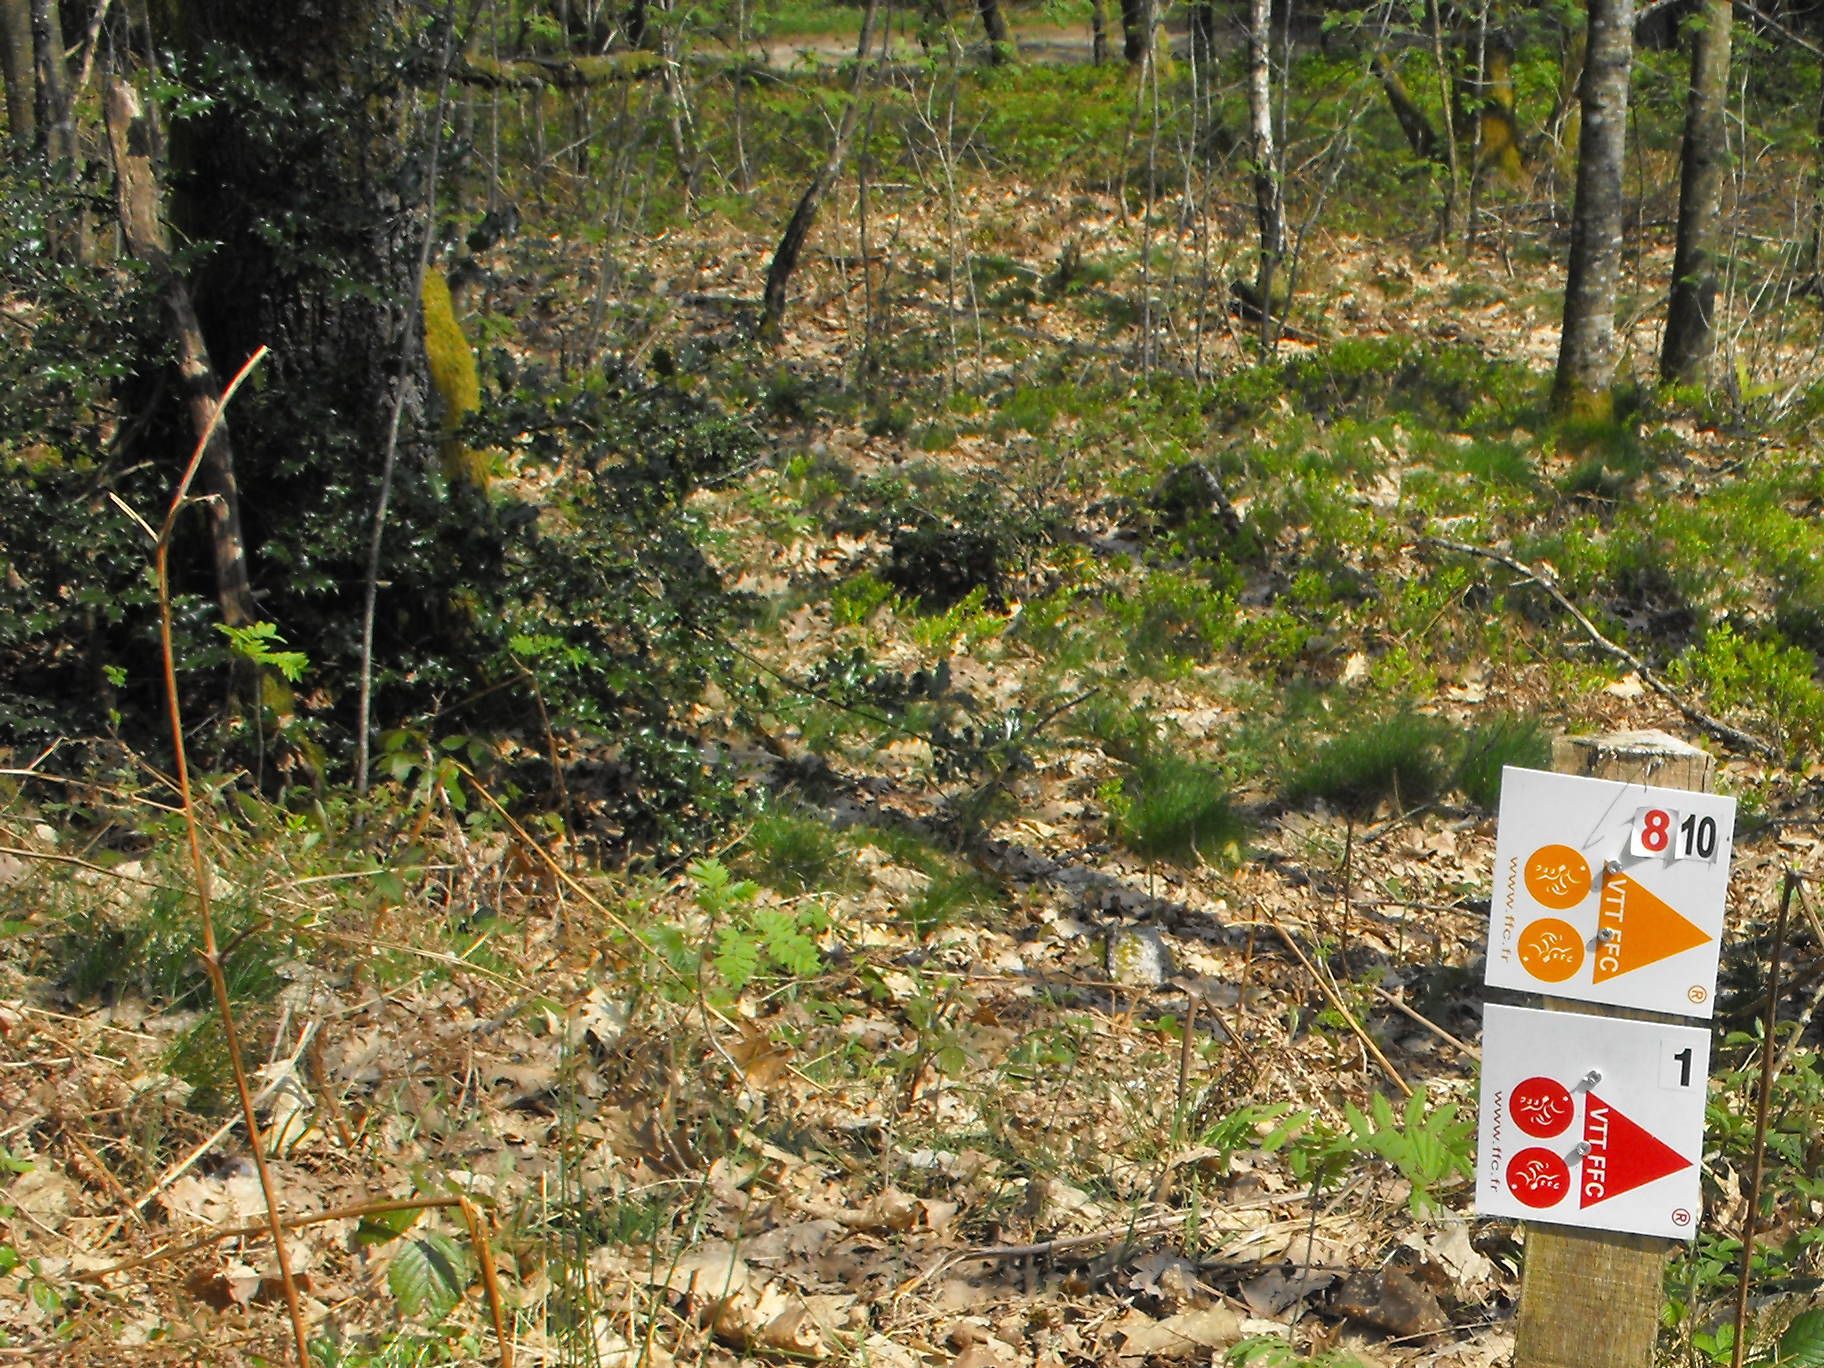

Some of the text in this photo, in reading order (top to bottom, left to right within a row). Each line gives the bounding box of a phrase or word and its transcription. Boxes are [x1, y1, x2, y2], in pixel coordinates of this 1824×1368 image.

[1641, 809, 1716, 858] 8 10
[1599, 879, 1627, 973] VTT FFC
[1674, 1048, 1693, 1087] 1
[1490, 1091, 1503, 1193] www.ffc.fr
[1584, 1107, 1609, 1200] VTT FFC
